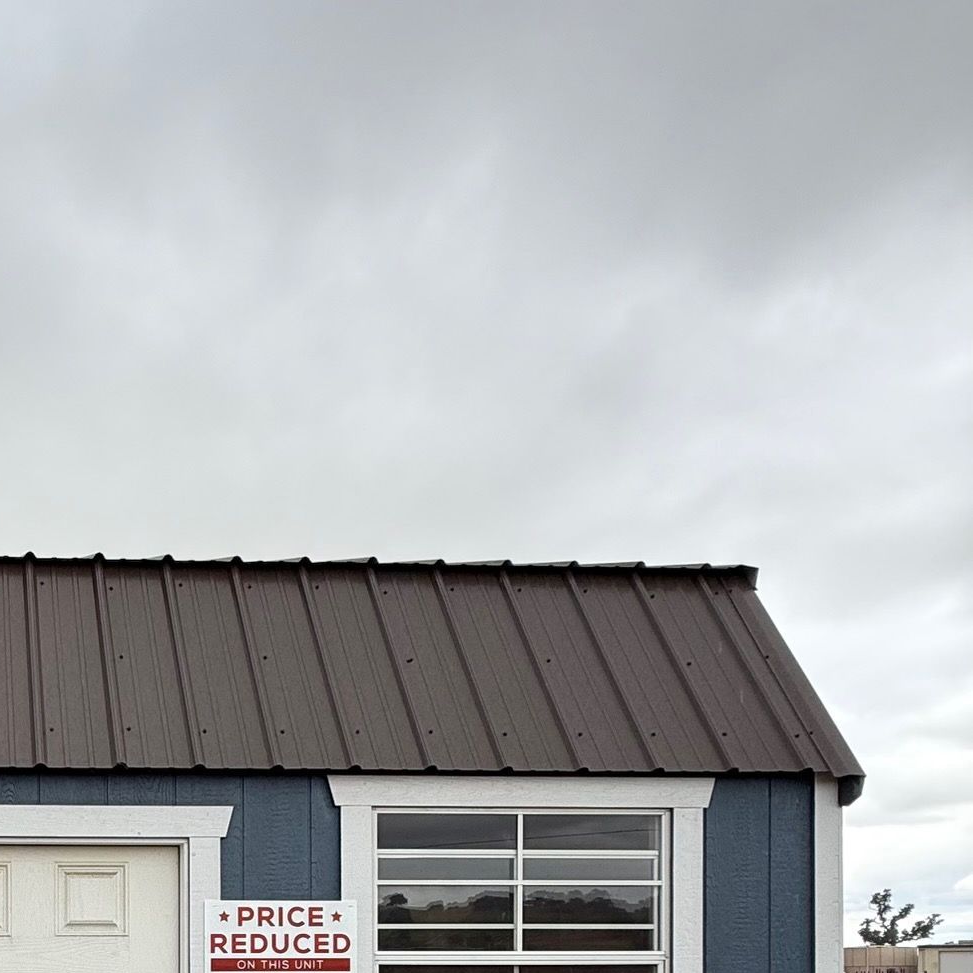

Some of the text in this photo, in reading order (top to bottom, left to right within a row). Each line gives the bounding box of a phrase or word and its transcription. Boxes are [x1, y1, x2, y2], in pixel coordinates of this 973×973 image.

[237, 906, 324, 927] PRICE
[210, 933, 351, 954] REDUCED
[236, 959, 324, 970] ON THIS UNIT
